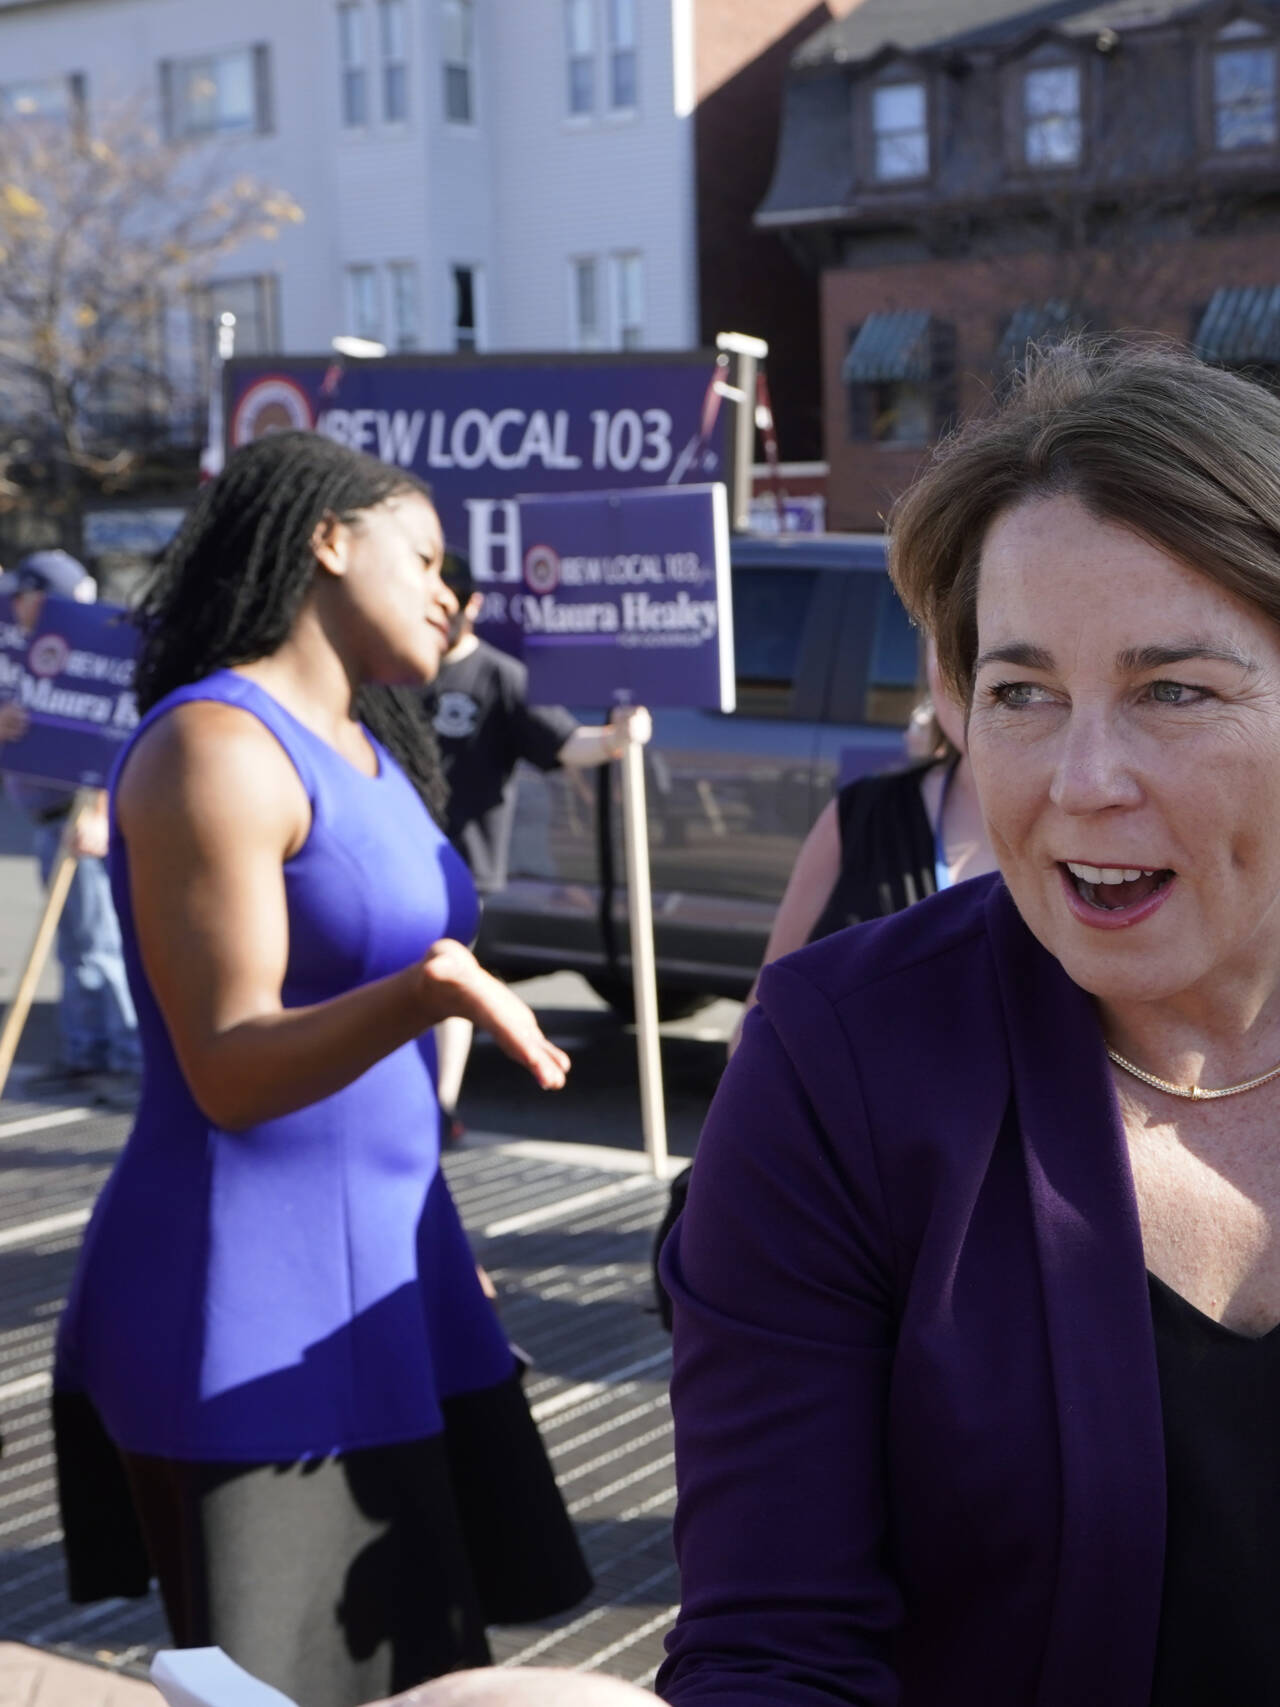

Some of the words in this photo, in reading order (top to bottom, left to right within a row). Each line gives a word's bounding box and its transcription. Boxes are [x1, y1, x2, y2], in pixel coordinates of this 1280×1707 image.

[428, 408, 582, 471] LOCAL
[589, 408, 673, 472] 103
[604, 554, 665, 585] LOCAL
[522, 594, 619, 634] Maura
[620, 590, 718, 641] Healey
